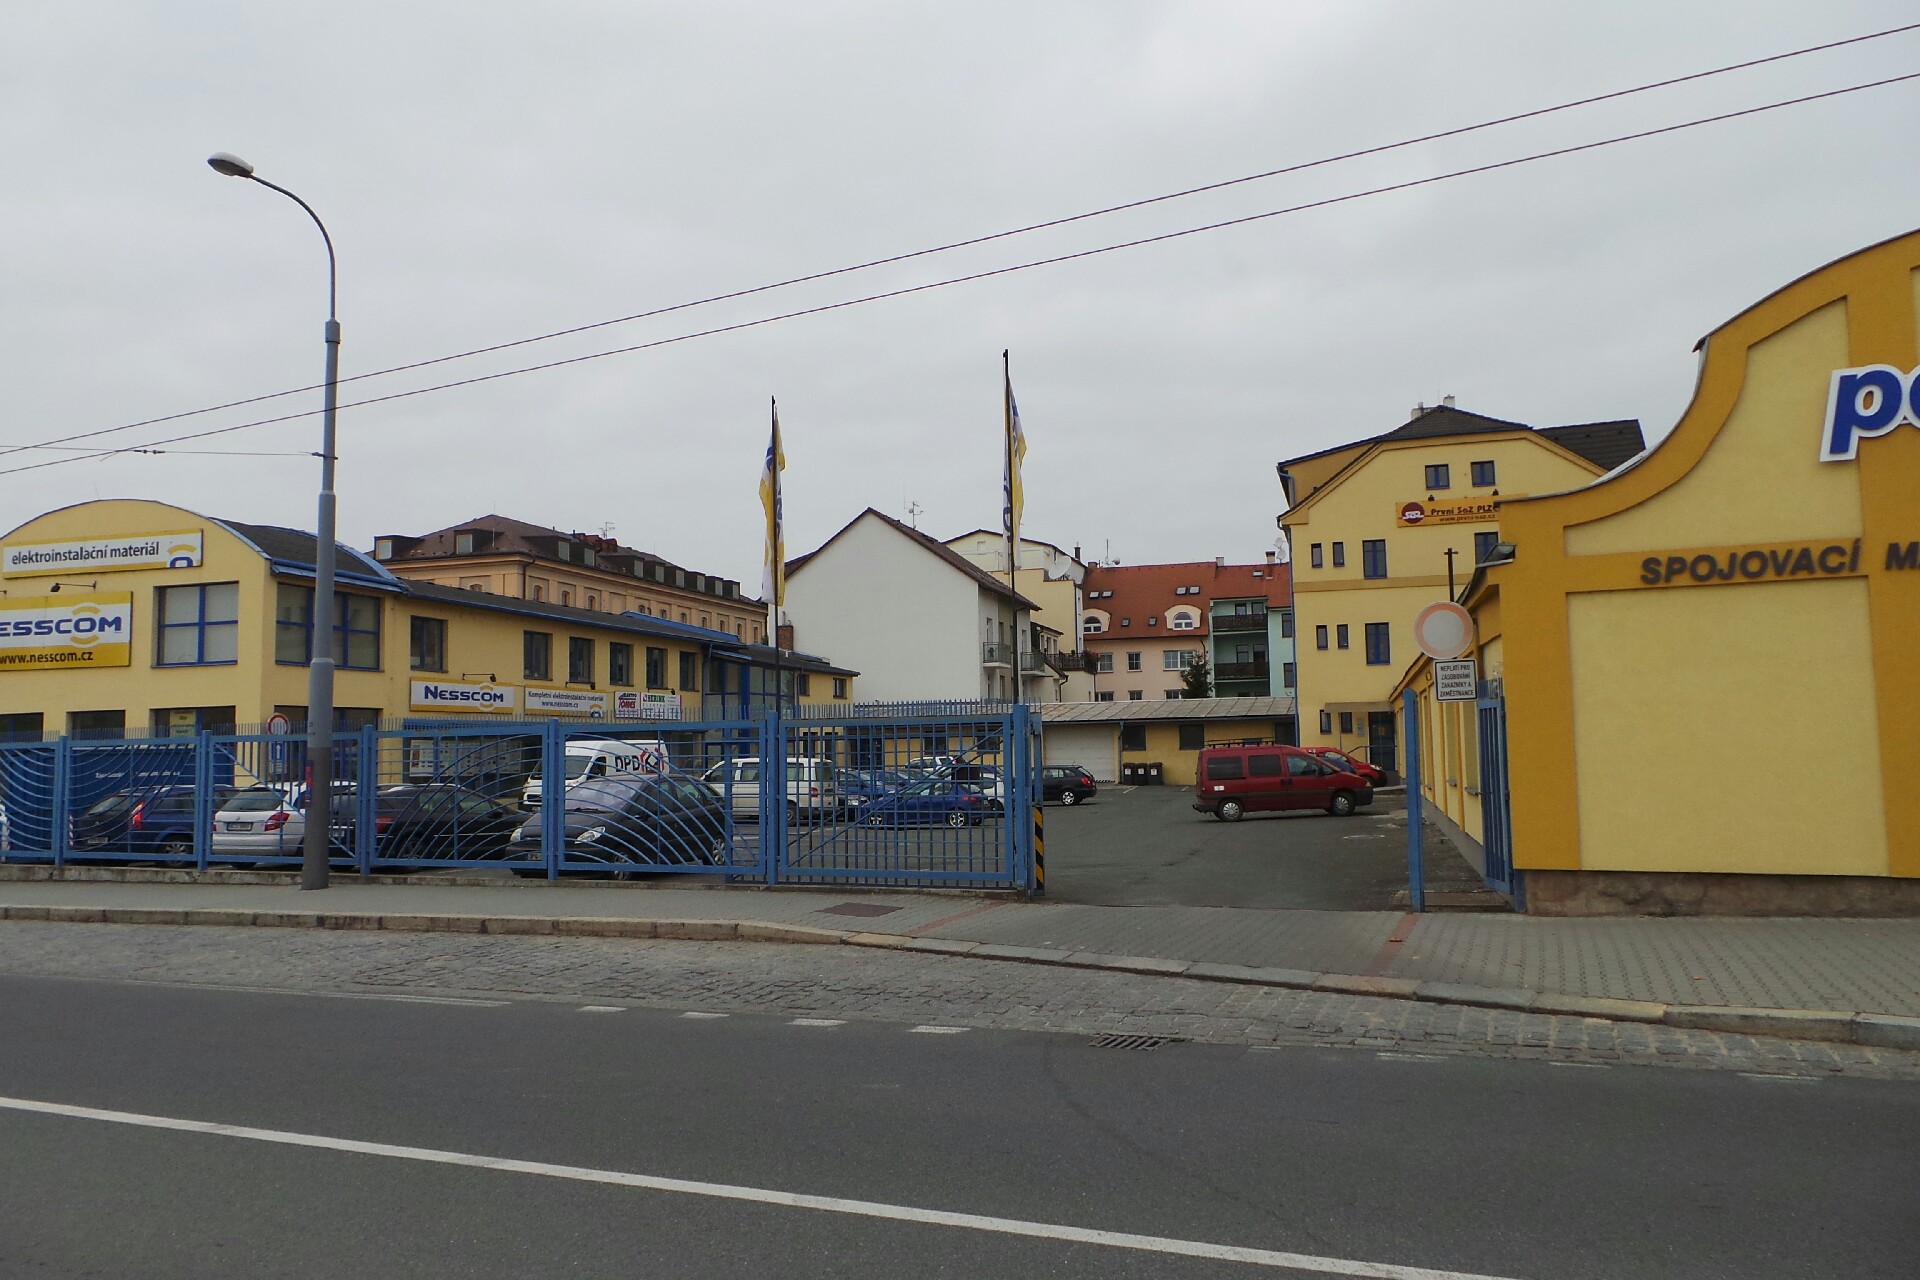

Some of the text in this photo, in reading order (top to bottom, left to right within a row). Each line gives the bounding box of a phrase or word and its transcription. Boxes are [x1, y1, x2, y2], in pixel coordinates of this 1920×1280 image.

[1826, 367, 1920, 457] p
[12, 542, 160, 565] elektroinstalační materiál
[1641, 538, 1920, 584] SPOJOVACÍ M
[0, 651, 94, 664] www.nesscom.cz
[615, 754, 640, 772] DPD
